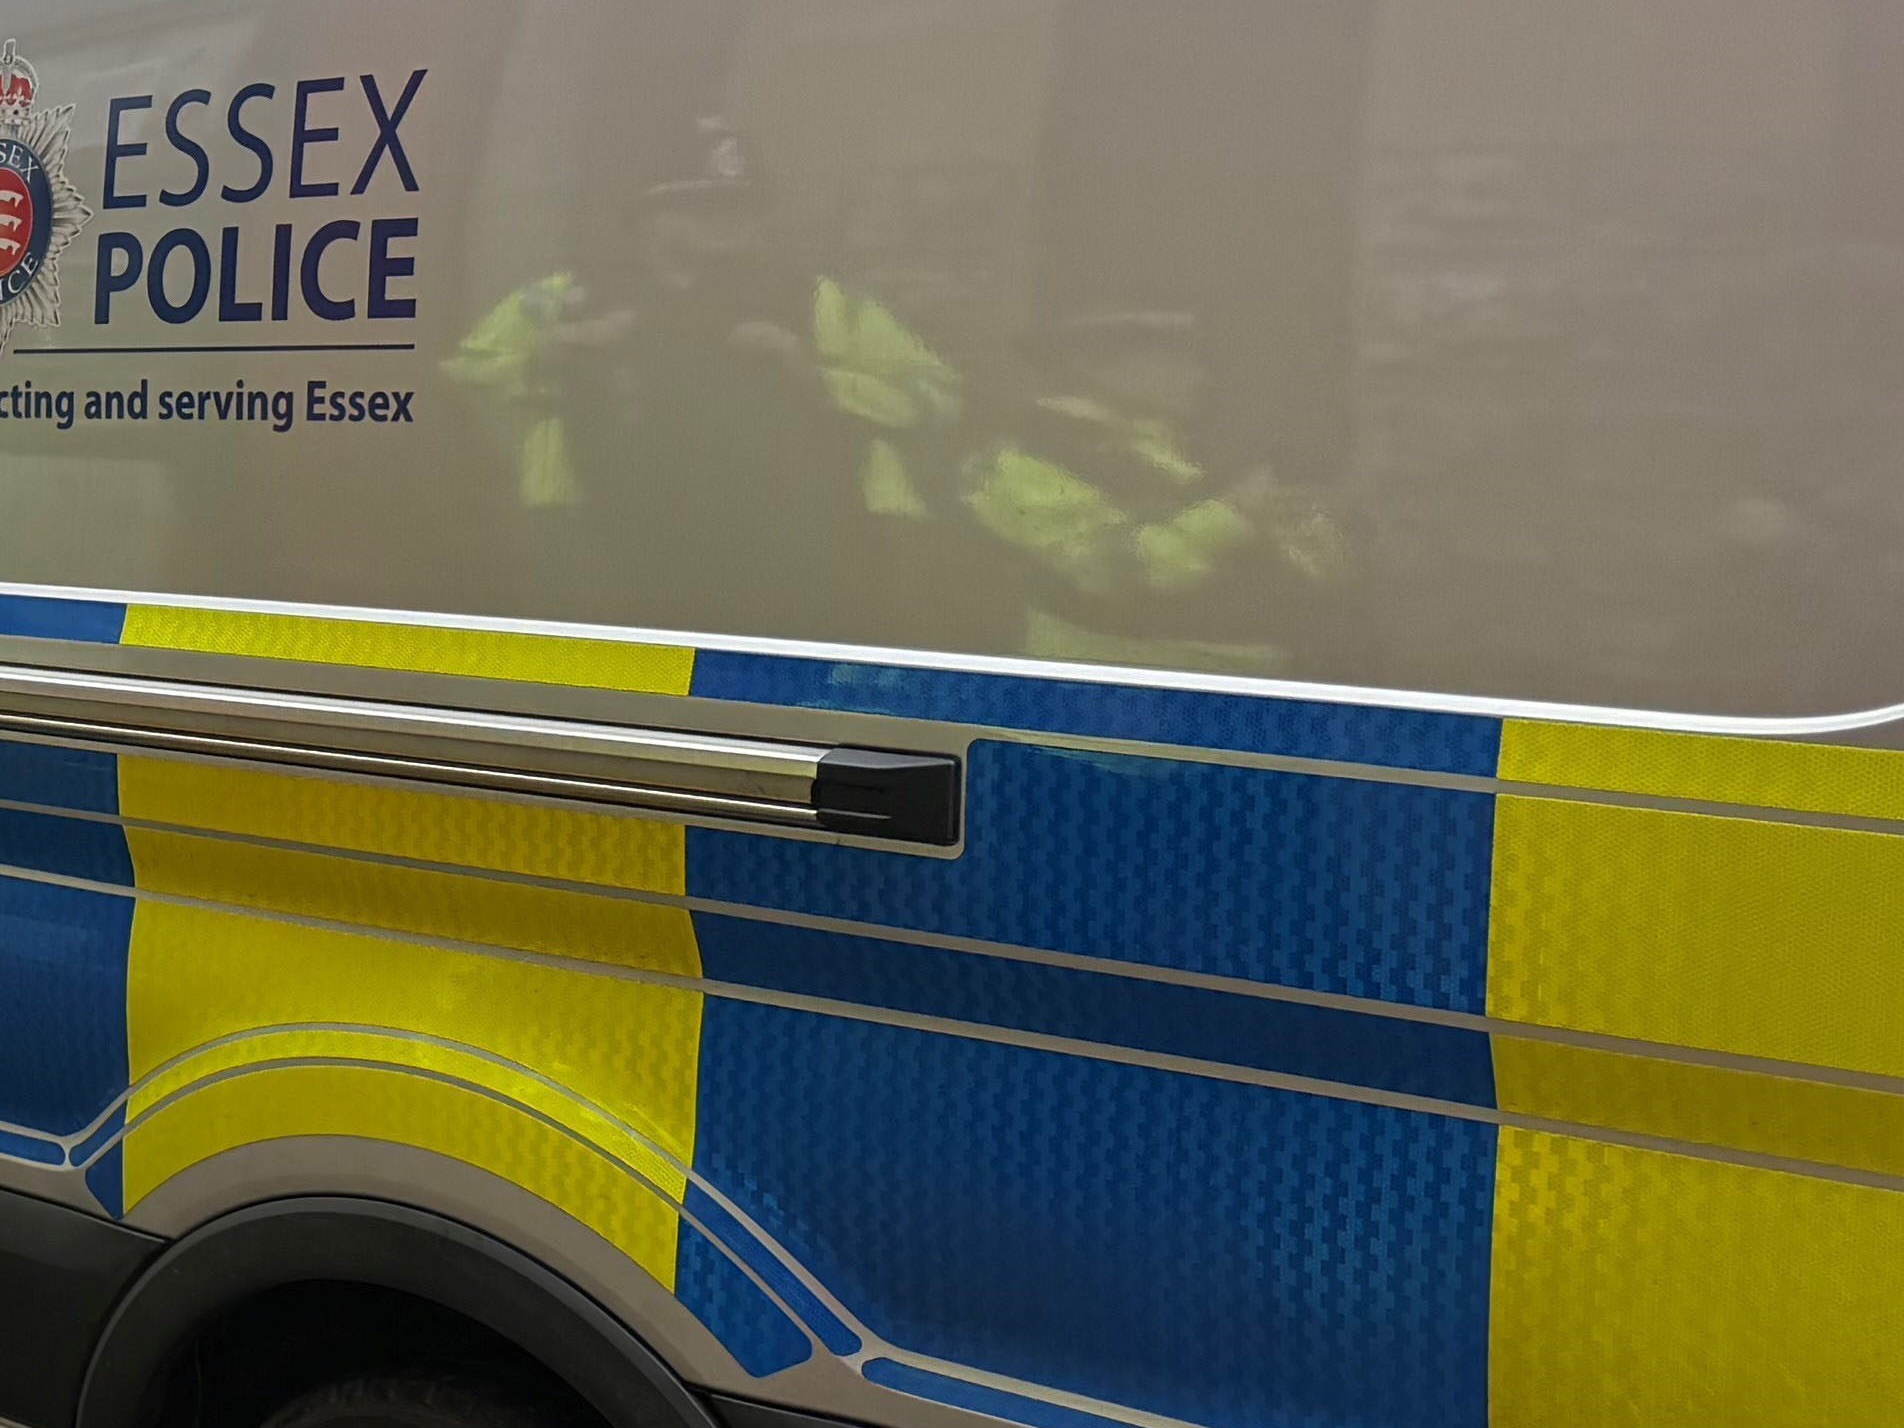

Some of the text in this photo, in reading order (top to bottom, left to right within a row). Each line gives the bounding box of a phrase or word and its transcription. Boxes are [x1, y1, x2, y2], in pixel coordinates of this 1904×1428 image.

[101, 68, 428, 210] ESSEX
[93, 217, 419, 325] POLICE
[84, 380, 148, 421] and
[158, 379, 293, 432] serving
[306, 380, 414, 423] Essex
